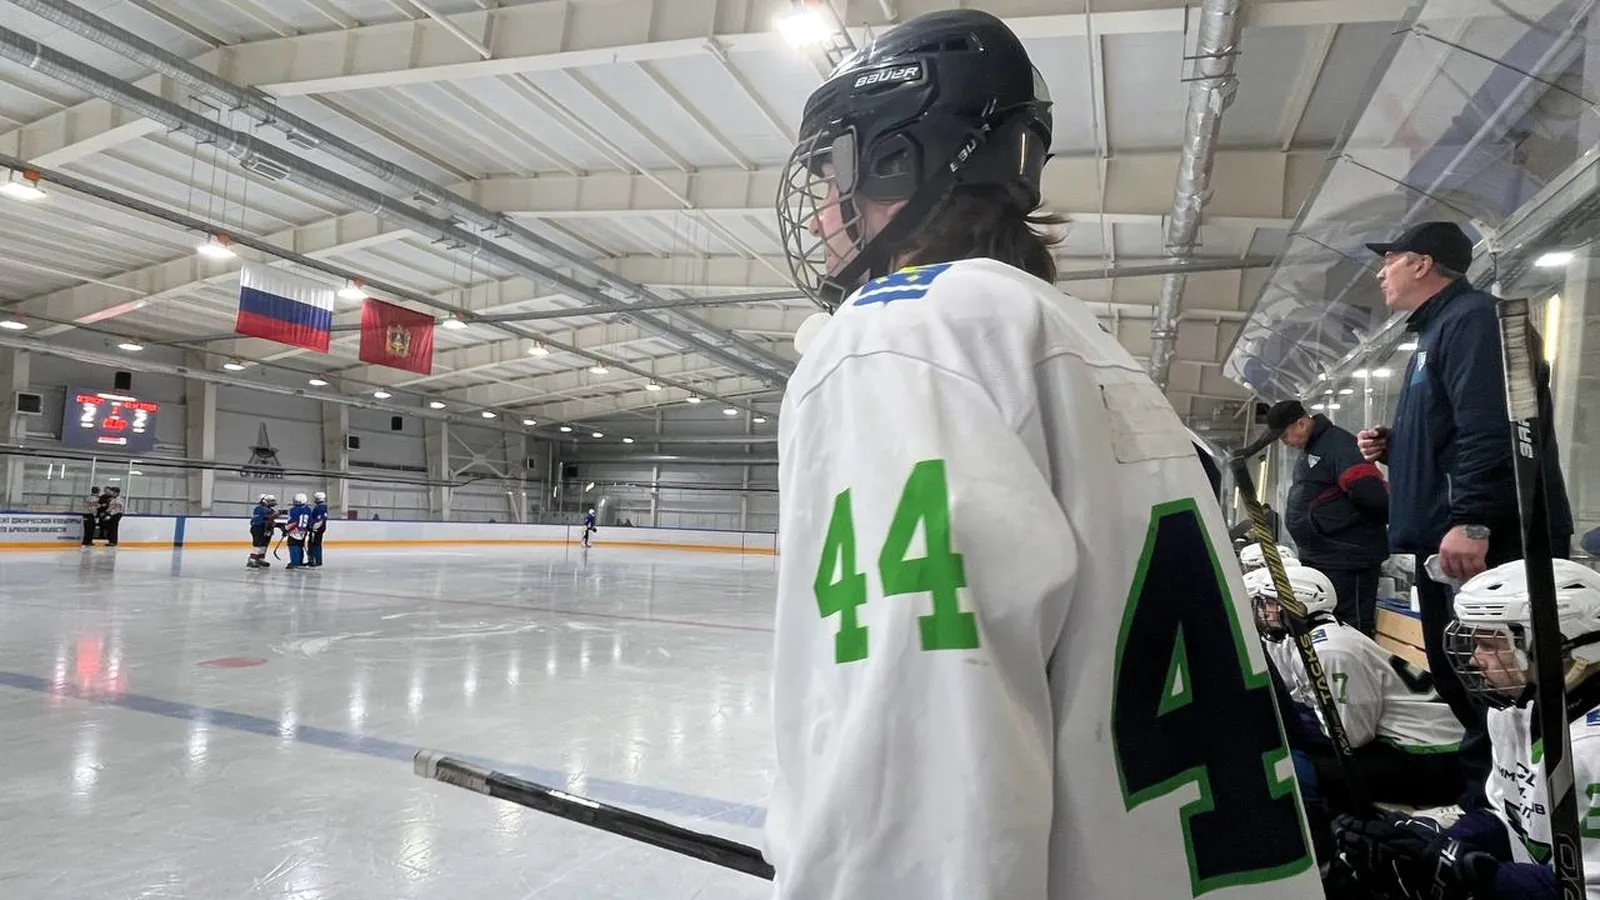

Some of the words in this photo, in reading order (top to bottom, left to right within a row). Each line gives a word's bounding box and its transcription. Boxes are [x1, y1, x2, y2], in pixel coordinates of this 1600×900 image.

[854, 65, 920, 88] BAUER
[813, 459, 982, 665] 44
[1110, 497, 1314, 899] 4
[1299, 633, 1331, 705] TACKS
[1331, 672, 1349, 705] 7
